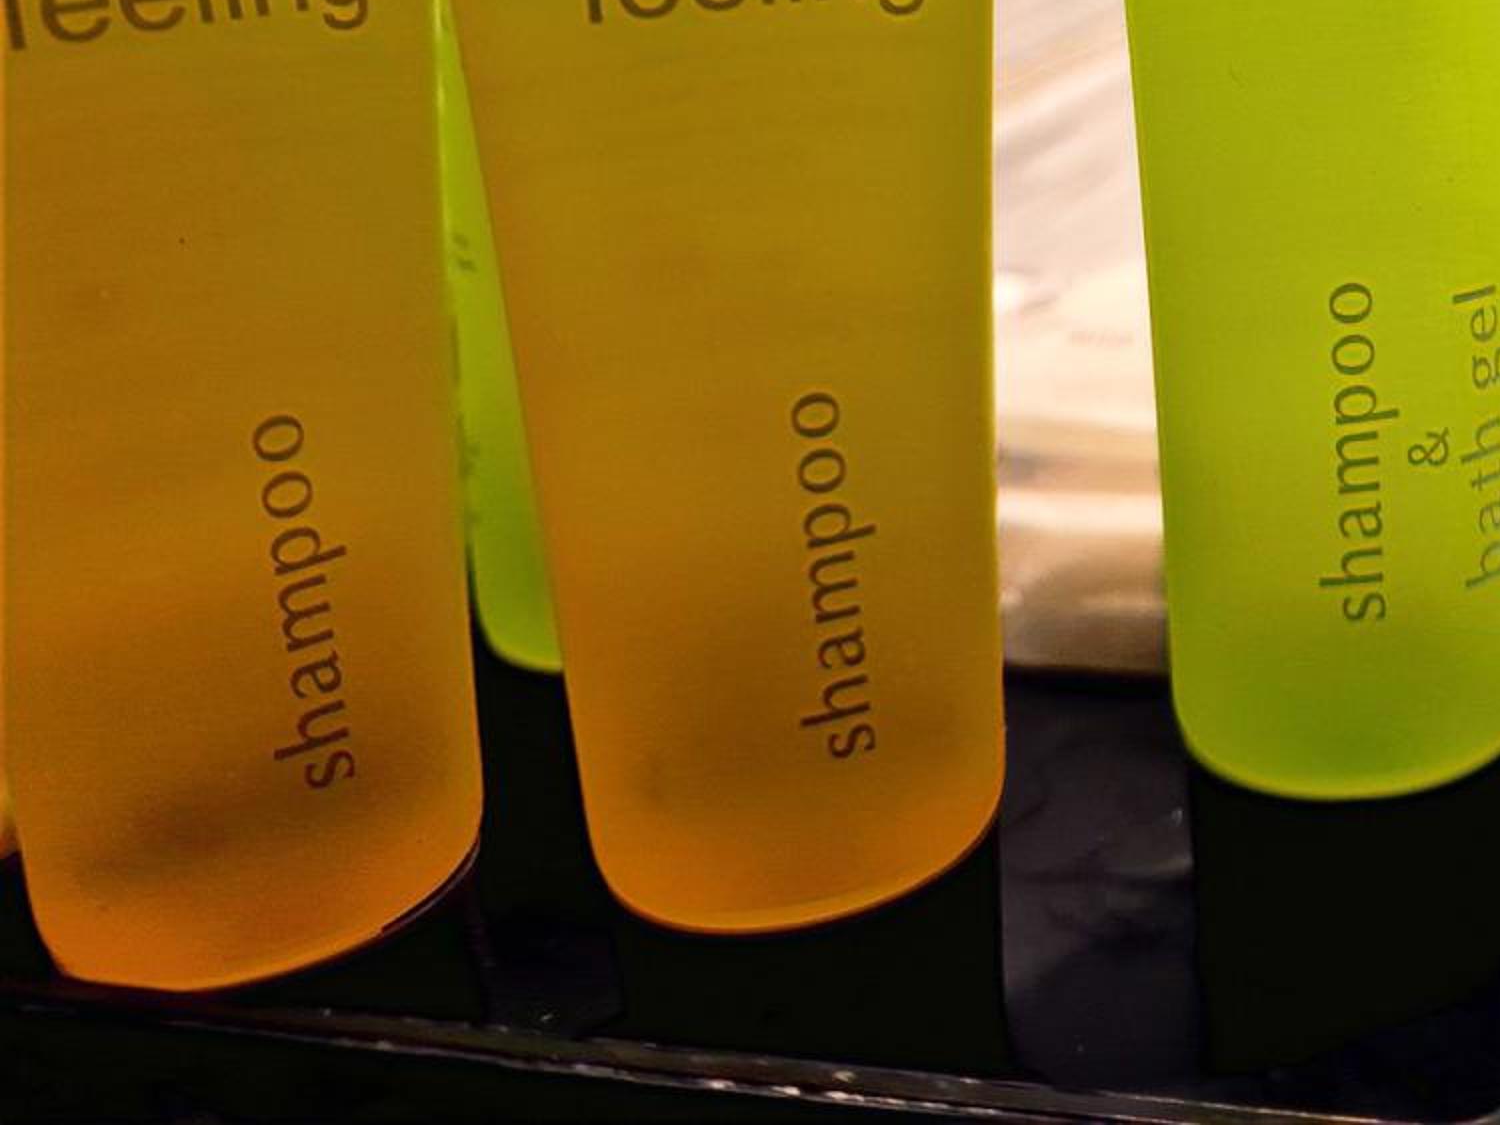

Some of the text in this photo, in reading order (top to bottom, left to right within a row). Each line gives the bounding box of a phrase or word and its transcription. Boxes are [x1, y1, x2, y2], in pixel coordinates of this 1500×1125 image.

[251, 413, 355, 790] shampoo
[789, 391, 877, 760] shampoo
[1318, 281, 1400, 624] shampoo
[1406, 426, 1451, 467] &
